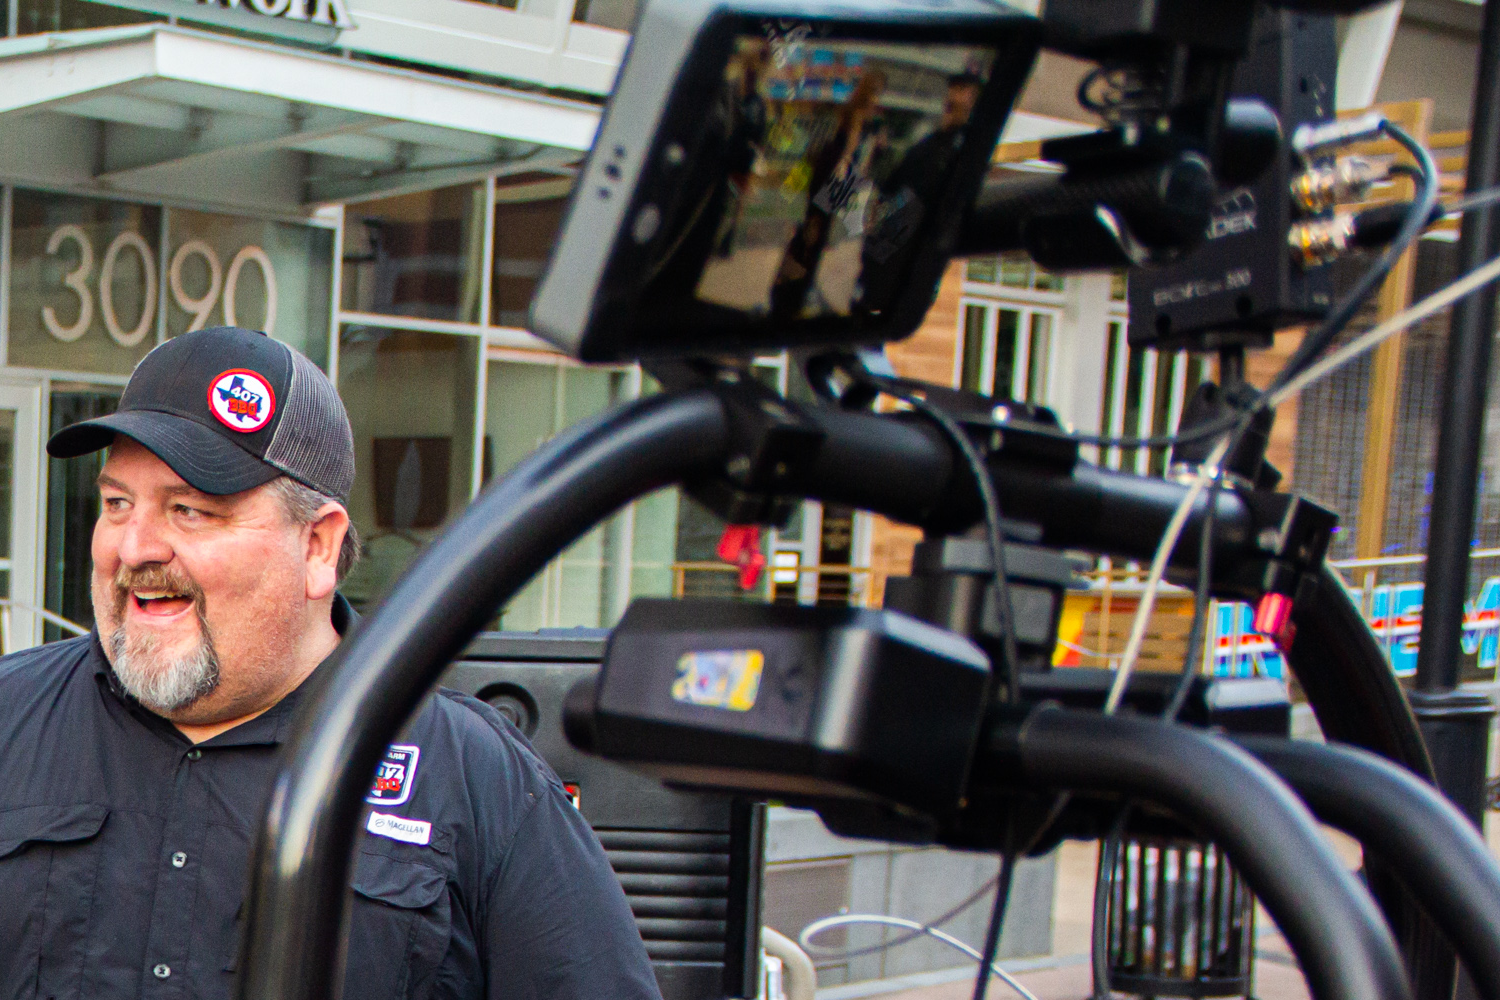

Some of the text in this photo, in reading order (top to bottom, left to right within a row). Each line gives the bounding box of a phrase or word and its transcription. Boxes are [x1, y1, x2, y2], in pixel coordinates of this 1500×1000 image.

[42, 225, 277, 347] 3090
[230, 386, 260, 404] 407
[373, 777, 401, 791] BQ
[386, 820, 425, 834] MAGELLAN
